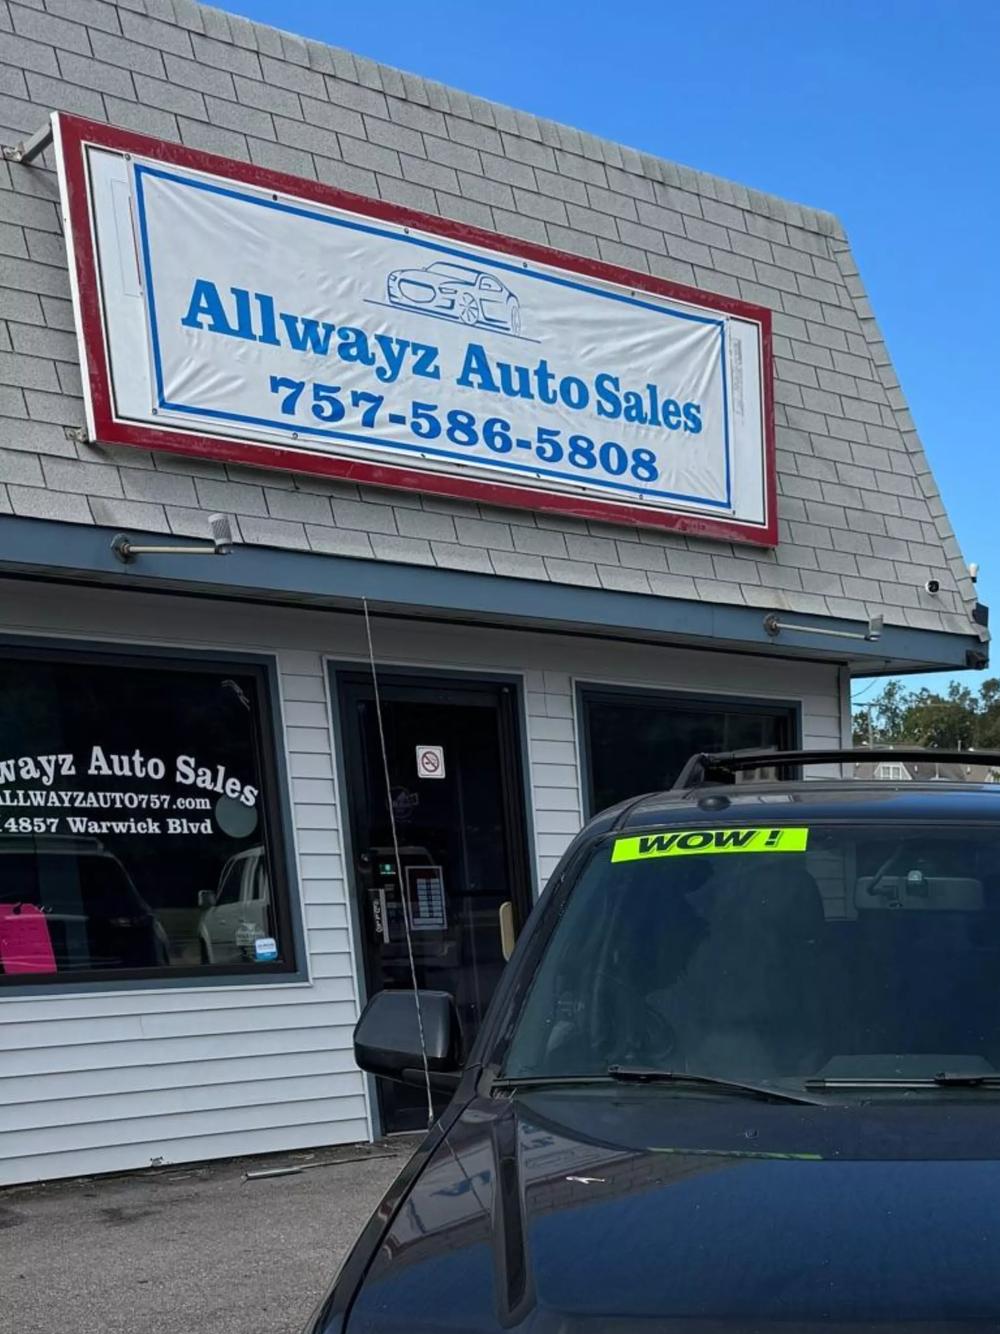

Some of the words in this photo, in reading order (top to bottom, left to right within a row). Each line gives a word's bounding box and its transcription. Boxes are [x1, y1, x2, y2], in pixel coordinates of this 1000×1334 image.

[181, 278, 441, 383] Allwayz
[456, 343, 589, 410] Auto
[595, 373, 702, 434] Sales
[270, 375, 659, 482] 757-586-5808
[88, 745, 165, 779] Auto
[176, 755, 259, 807] Sales
[0, 817, 59, 833] 4857
[66, 817, 161, 835] Warwick
[166, 817, 213, 835] Blvd
[638, 830, 761, 854] WOW
